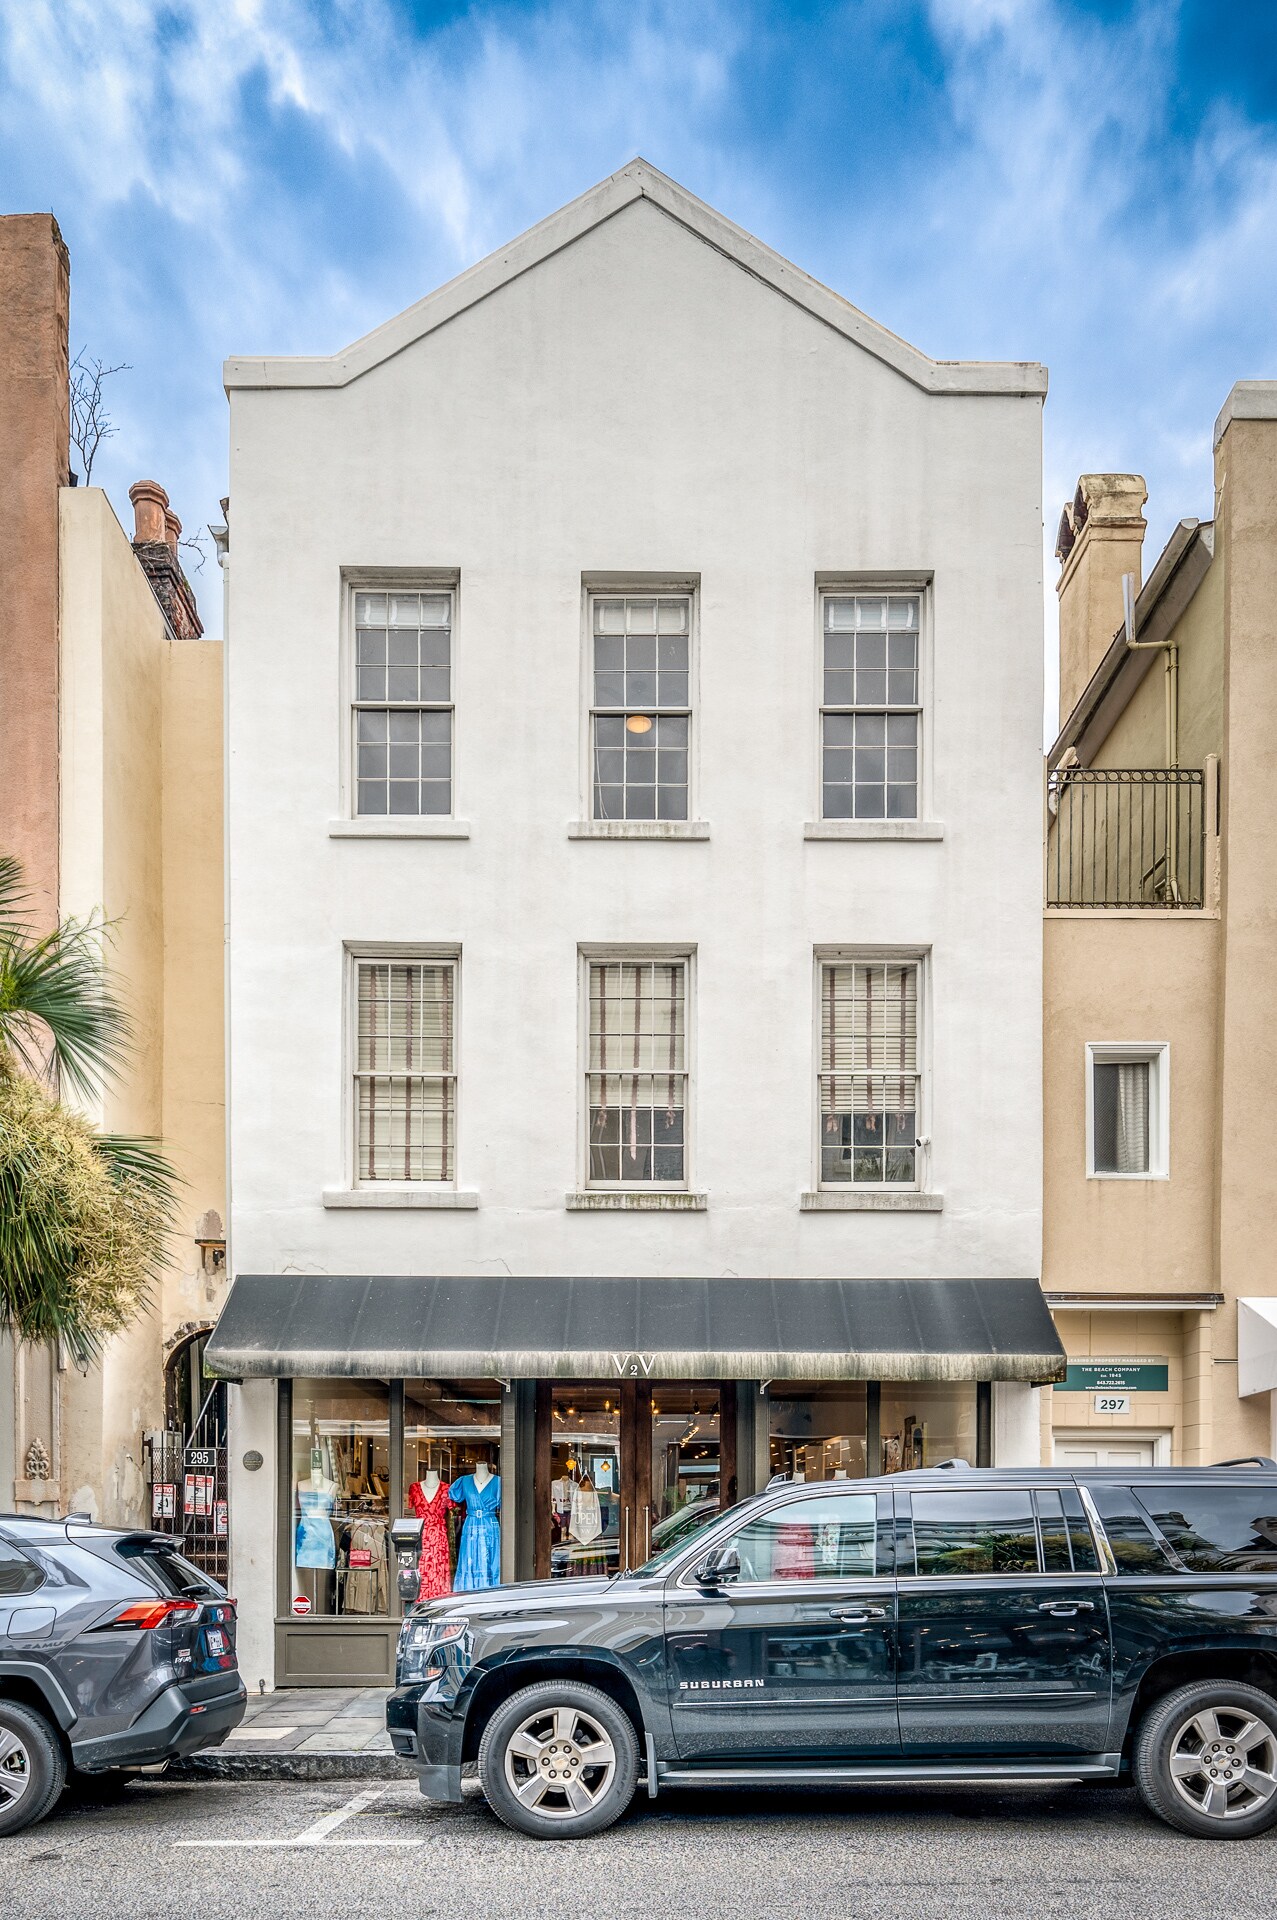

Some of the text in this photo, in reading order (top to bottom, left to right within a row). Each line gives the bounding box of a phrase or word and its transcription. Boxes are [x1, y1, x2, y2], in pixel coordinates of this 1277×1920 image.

[611, 1353, 657, 1376] V2V
[1100, 1399, 1125, 1410] 297
[190, 1452, 209, 1464] 295
[574, 1512, 598, 1525] OPEN
[679, 1679, 764, 1689] SUBURBAN
